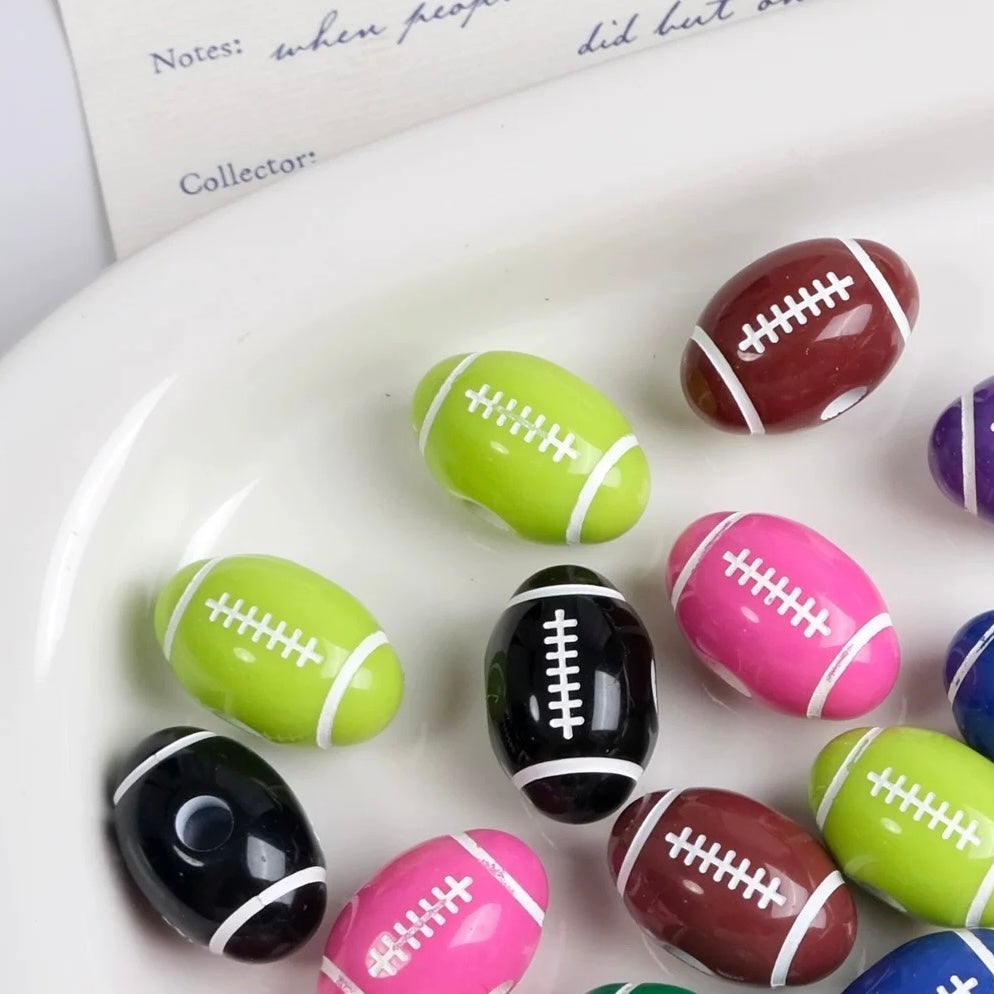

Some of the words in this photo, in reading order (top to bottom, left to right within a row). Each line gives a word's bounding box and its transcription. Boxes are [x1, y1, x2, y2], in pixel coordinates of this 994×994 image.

[269, 10, 387, 61] when
[577, 13, 640, 56] did
[653, 0, 735, 36] but
[150, 38, 242, 74] Notes:
[179, 151, 317, 196] Collector:
